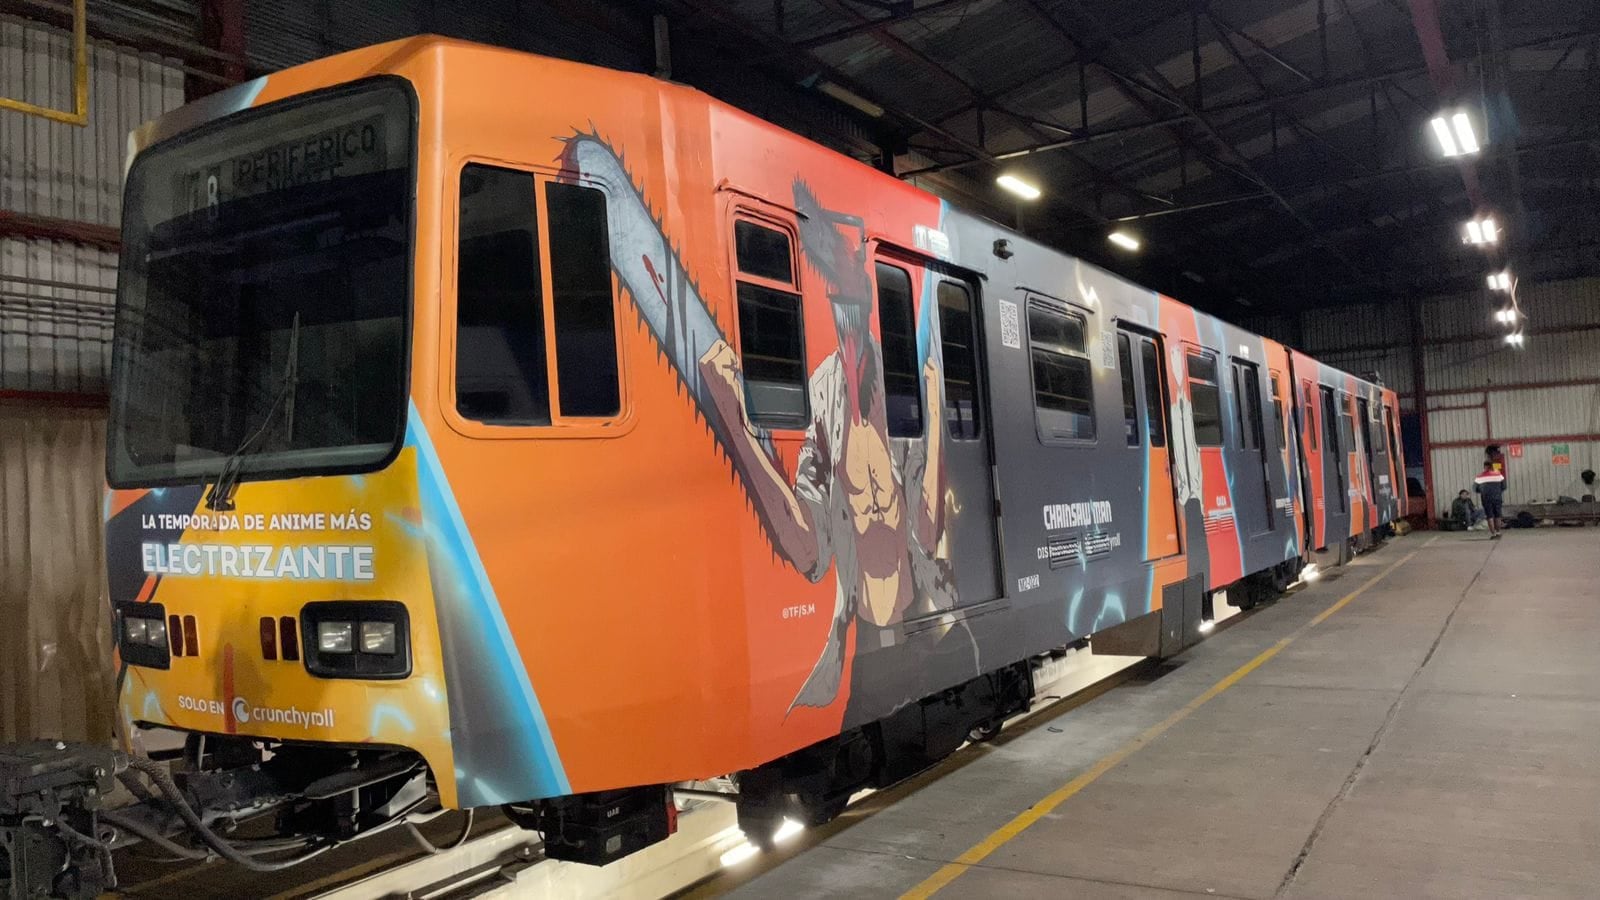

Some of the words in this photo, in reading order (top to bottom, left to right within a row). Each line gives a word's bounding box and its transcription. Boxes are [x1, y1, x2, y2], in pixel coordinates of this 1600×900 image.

[142, 514, 157, 529] LA
[159, 513, 240, 530] TEMPORADA
[244, 515, 265, 530] DE
[269, 515, 325, 530] ANIME
[330, 509, 372, 530] MÁS
[1043, 503, 1091, 529] CHAINSAW
[142, 543, 375, 579] ELECTRIZANTE
[178, 695, 207, 713] SOLO
[209, 700, 225, 715] EN
[254, 706, 335, 729] crunchyroll
